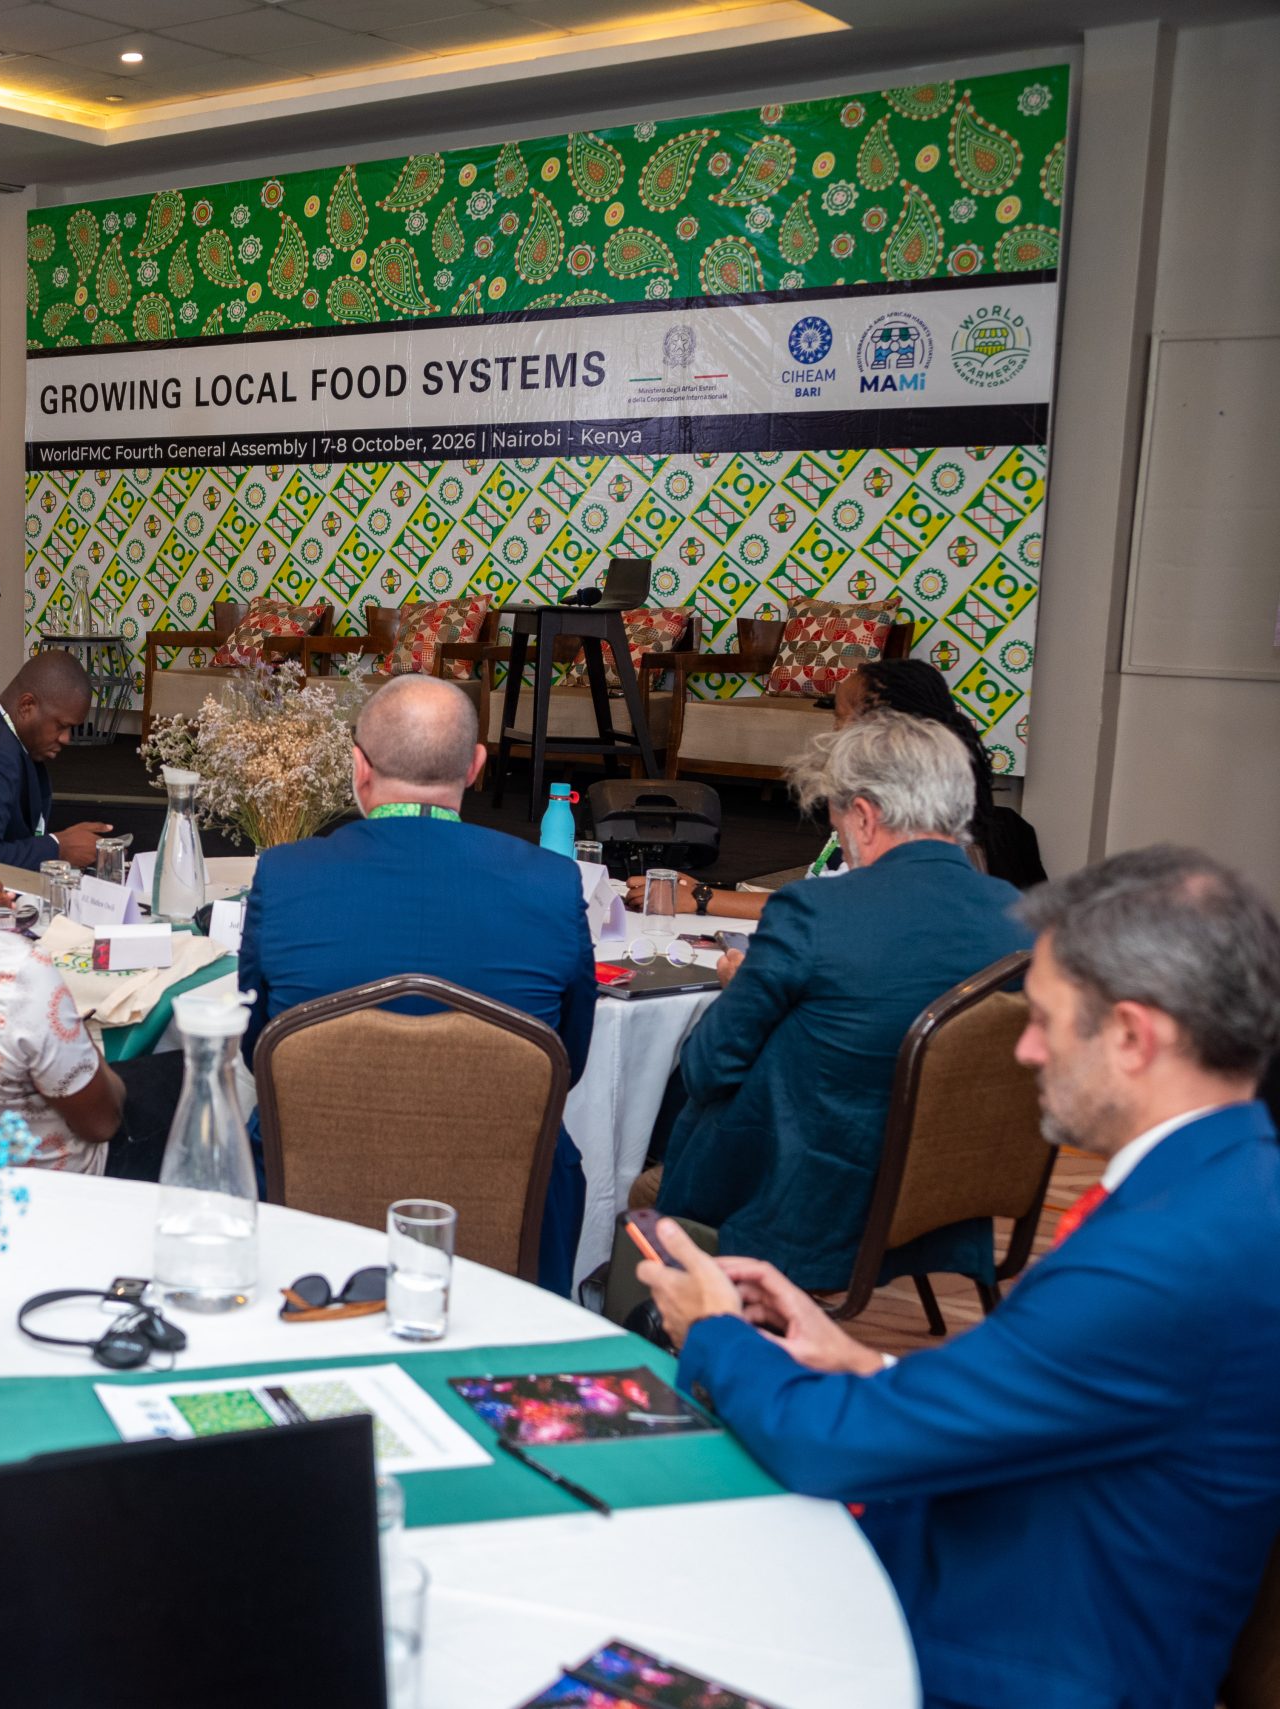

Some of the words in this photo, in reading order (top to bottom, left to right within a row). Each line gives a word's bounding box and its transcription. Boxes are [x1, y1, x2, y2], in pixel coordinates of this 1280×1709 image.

[959, 305, 1024, 331] WORLD
[781, 368, 836, 384] CIHEAM
[953, 361, 985, 388] MARKETS
[986, 358, 1028, 388] COALITION
[963, 358, 1017, 380] FARMERS
[40, 376, 182, 415] GROWING
[195, 371, 298, 408] LOCAL
[311, 363, 408, 402] FOOD
[422, 350, 607, 395] SYSTEMS
[795, 386, 821, 398] BARI
[860, 372, 926, 393] MAMi
[646, 394, 686, 404] Cooperazione
[39, 446, 112, 462] WorldFMC
[115, 443, 163, 460] Fourth
[167, 441, 226, 459] General
[230, 438, 308, 458] Assembly
[321, 437, 347, 454] 7-8
[352, 435, 428, 454] October,
[432, 432, 476, 450] 2026
[492, 428, 561, 448] Nairobi
[581, 428, 643, 448] Kenya
